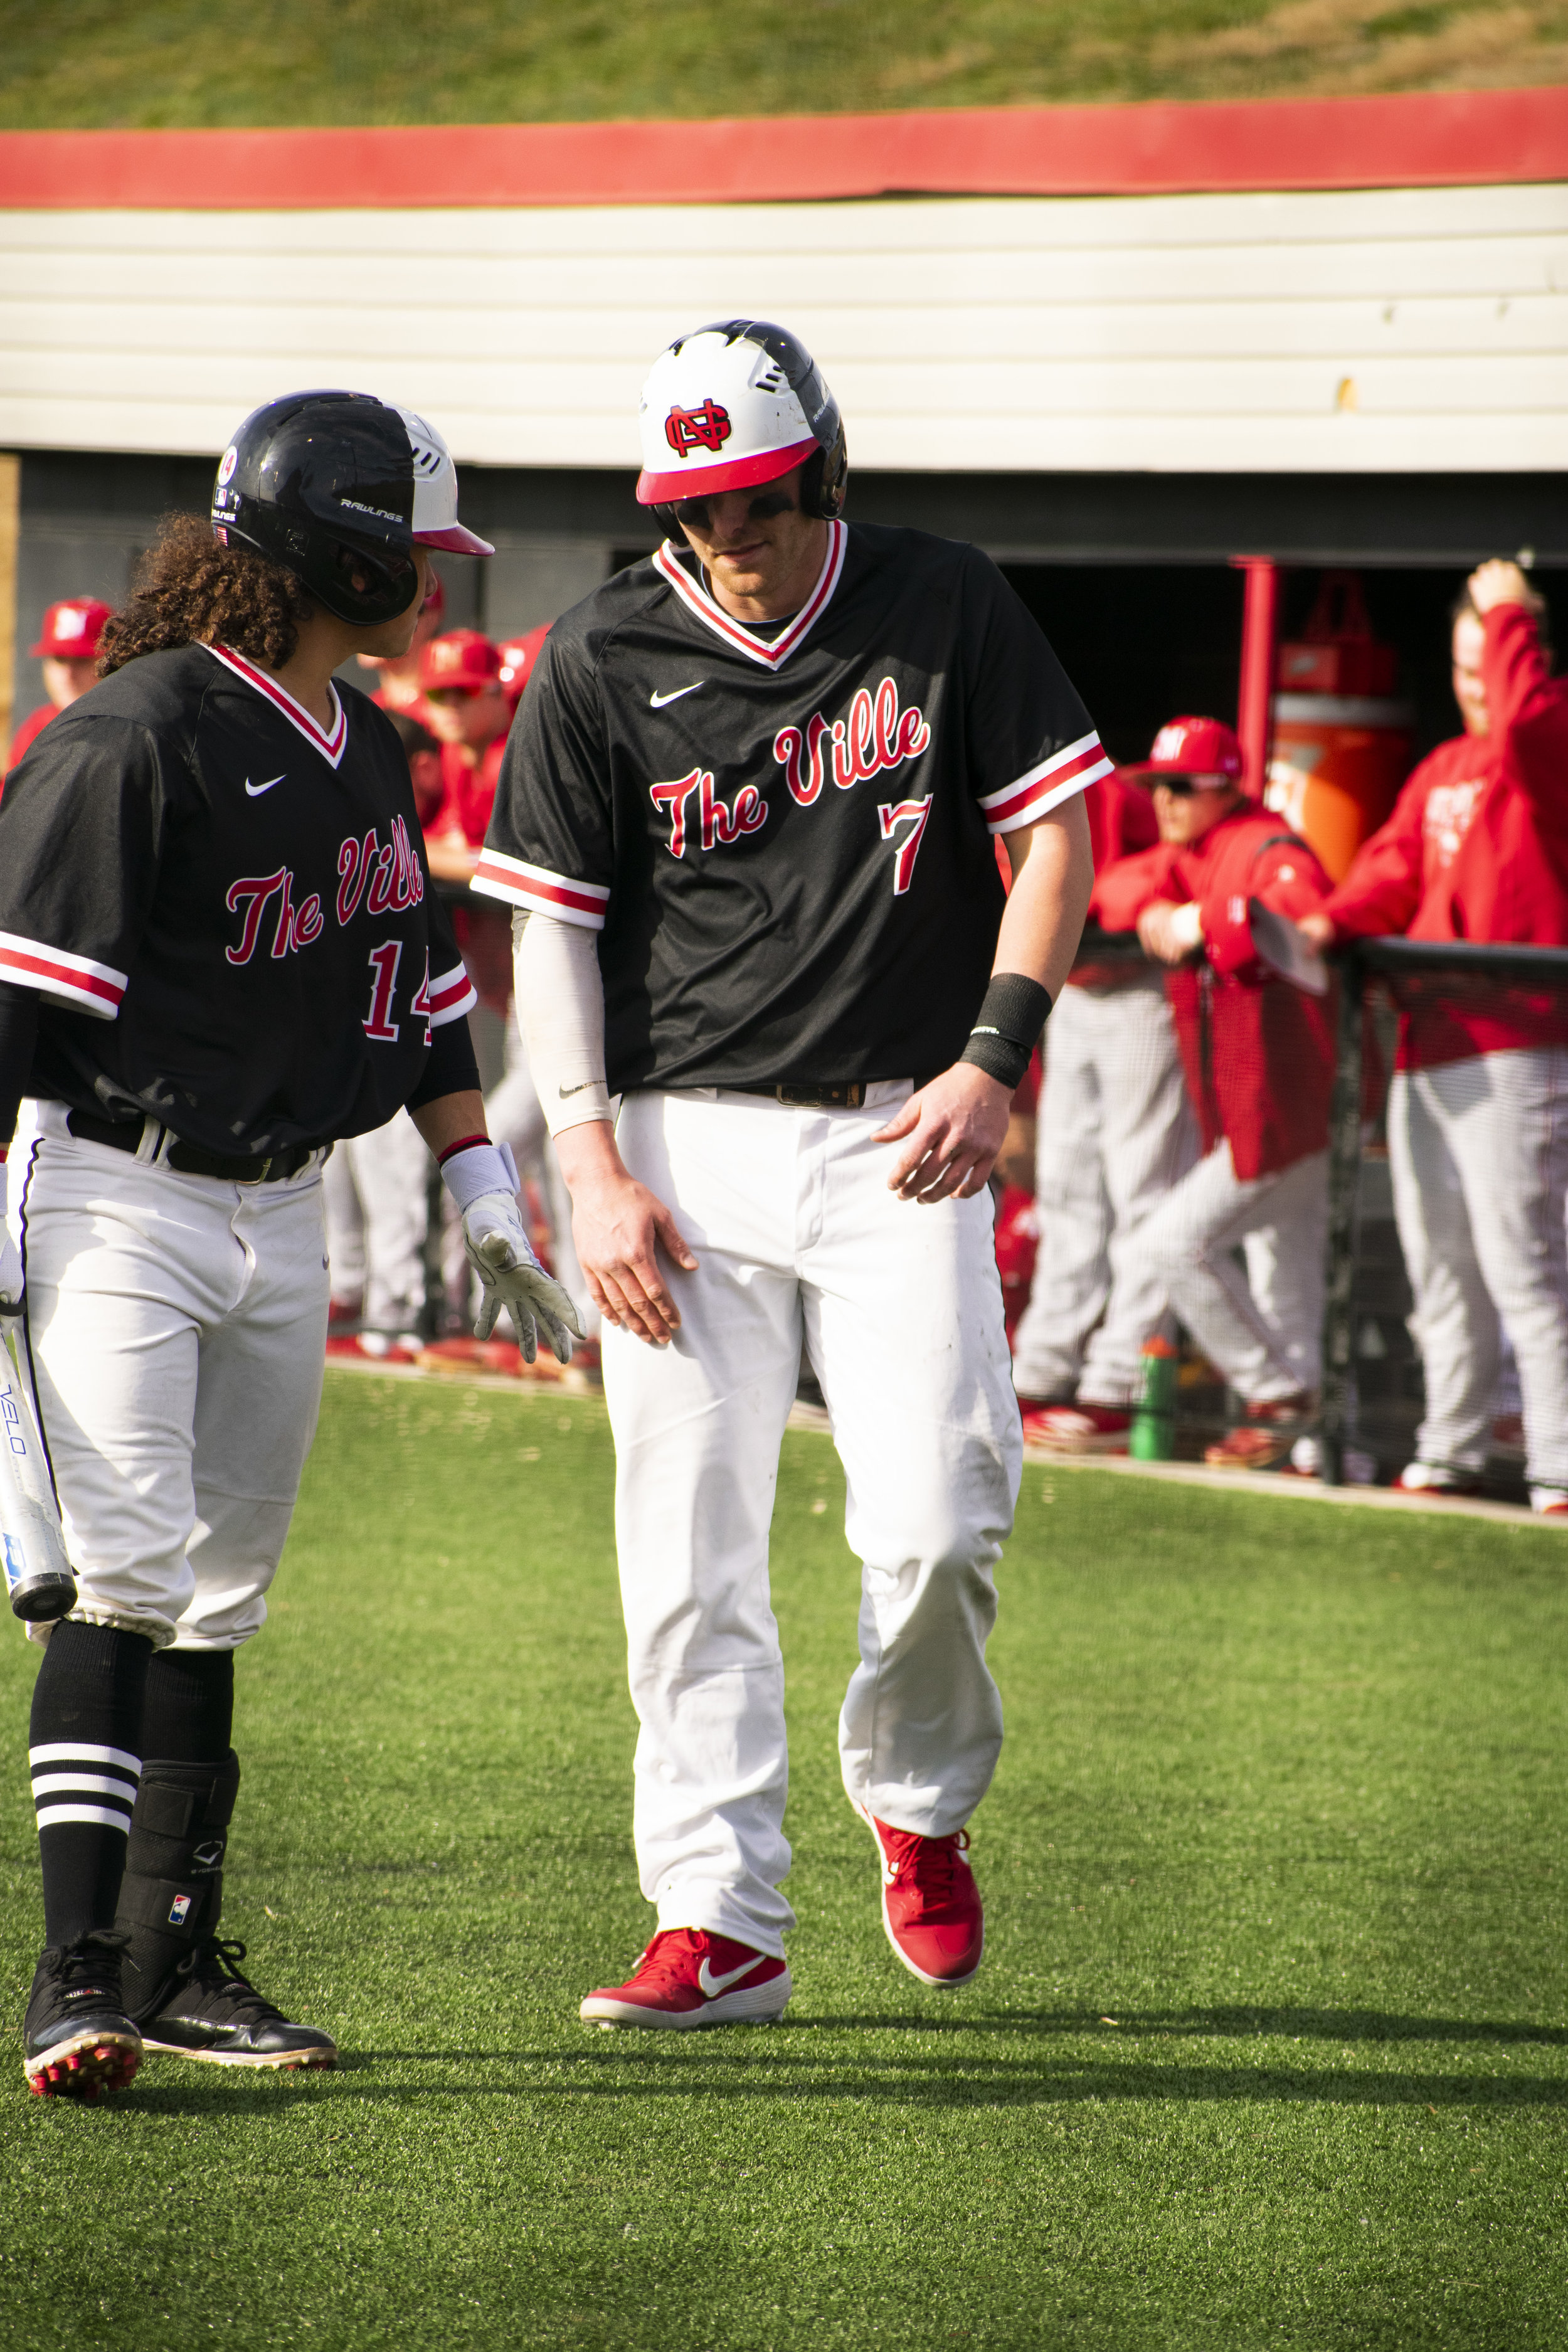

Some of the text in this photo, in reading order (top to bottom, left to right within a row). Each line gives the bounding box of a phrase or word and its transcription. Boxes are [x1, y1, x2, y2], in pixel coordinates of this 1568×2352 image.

[220, 453, 235, 477] 14
[341, 499, 403, 523] RAWLINGS
[650, 676, 931, 859] The Ville
[877, 793, 934, 895] 7
[225, 814, 424, 965] The Ville
[0, 1384, 26, 1455] VELO
